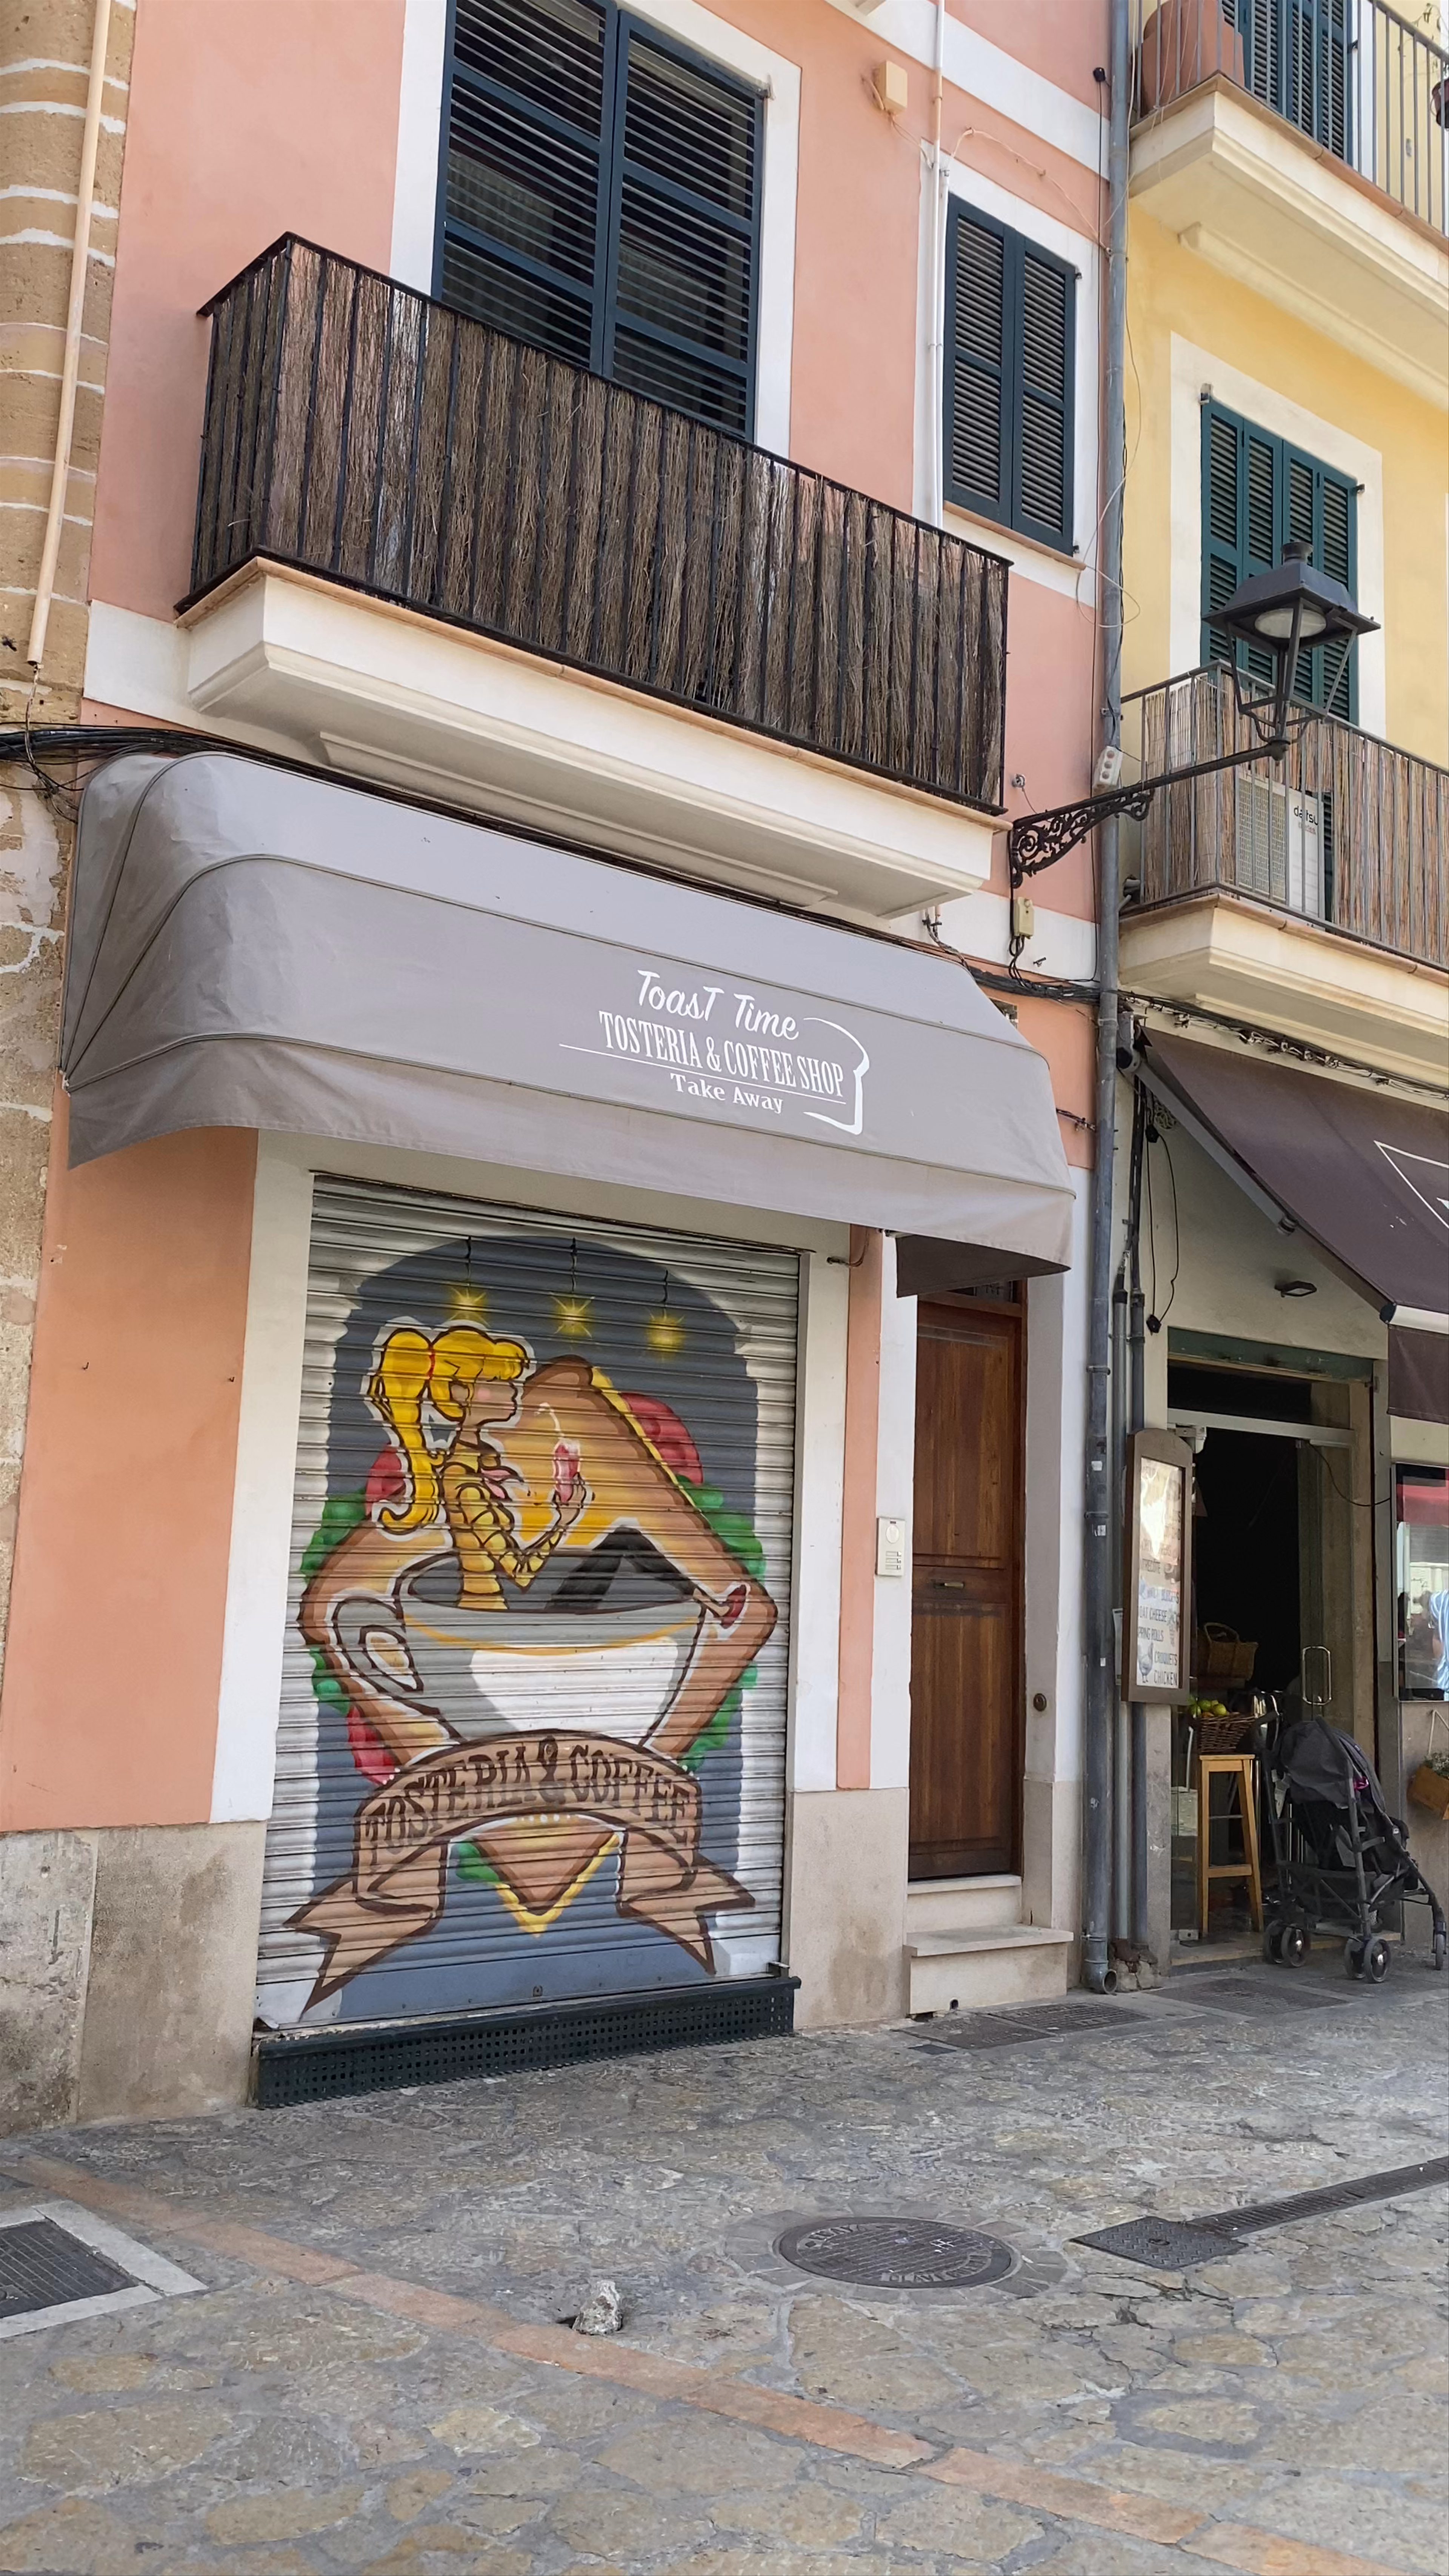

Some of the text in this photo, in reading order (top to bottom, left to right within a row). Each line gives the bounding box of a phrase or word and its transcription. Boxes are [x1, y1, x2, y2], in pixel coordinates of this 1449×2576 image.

[1294, 805, 1318, 826] datsu
[734, 993, 799, 1040] Time
[599, 1010, 843, 1097] TOSTERIA & COFFEE SHOP
[670, 1073, 783, 1114] Take Away
[1149, 1608, 1167, 1622] CHEESE
[1138, 1626, 1164, 1642] PRING ROLLS
[1154, 1669, 1178, 1686] CHICKEN
[365, 1746, 537, 1875] TOSTERIA
[569, 1744, 691, 1846] COFFEE
